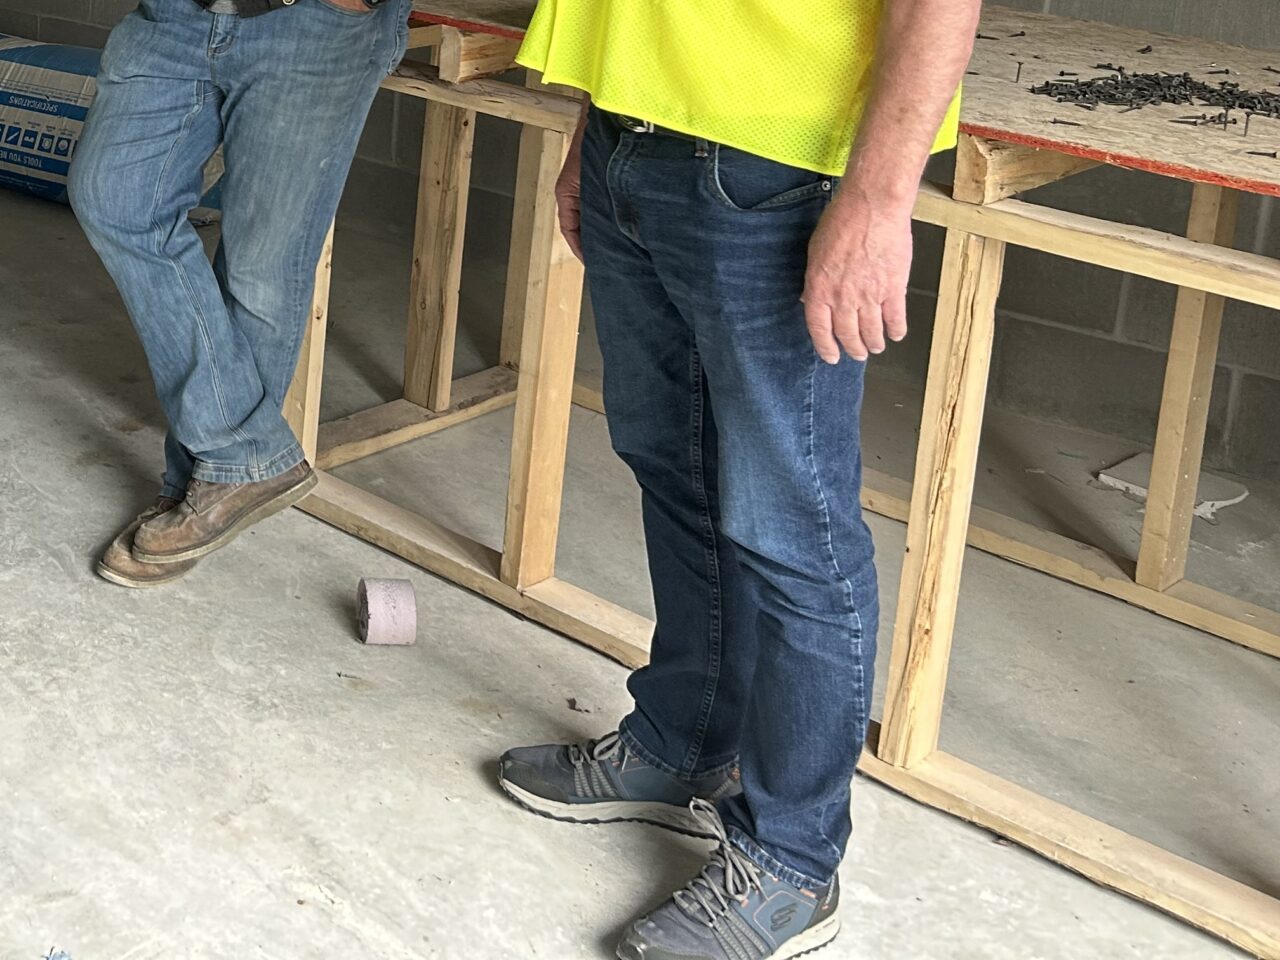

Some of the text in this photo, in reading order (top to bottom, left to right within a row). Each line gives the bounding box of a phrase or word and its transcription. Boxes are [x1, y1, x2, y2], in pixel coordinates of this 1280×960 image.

[9, 96, 58, 112] SPECIFICATIONS
[8, 152, 22, 162] YOU
[24, 156, 42, 168] TOOLS
